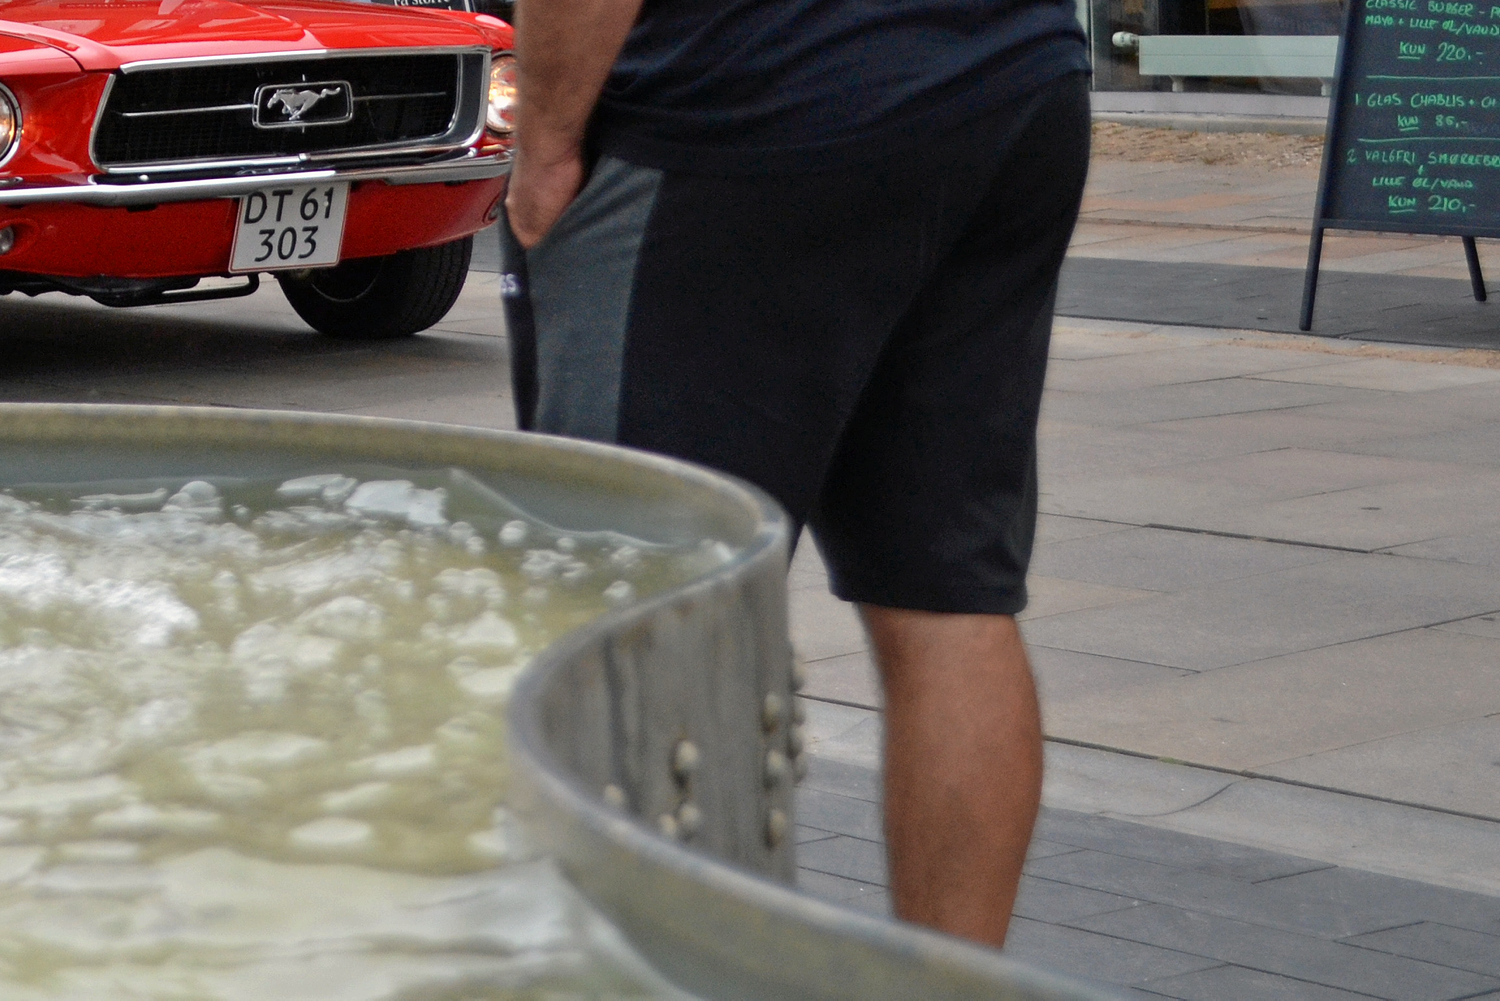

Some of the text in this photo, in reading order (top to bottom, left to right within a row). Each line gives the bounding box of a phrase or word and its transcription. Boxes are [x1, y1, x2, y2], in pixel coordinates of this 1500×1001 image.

[1428, 0, 1474, 17] BURGER
[1365, 15, 1394, 25] MAYO
[1410, 18, 1439, 30] LILLE
[1400, 41, 1426, 54] KUN
[1367, 93, 1402, 107] GLAS
[1410, 93, 1465, 108] CHABLIS
[1397, 115, 1418, 127] KUN
[1365, 150, 1415, 165] VALGFRI
[1372, 176, 1405, 187] LILLE
[243, 186, 334, 224] DT 61
[1388, 195, 1416, 207] KUN
[254, 225, 319, 262] 303
